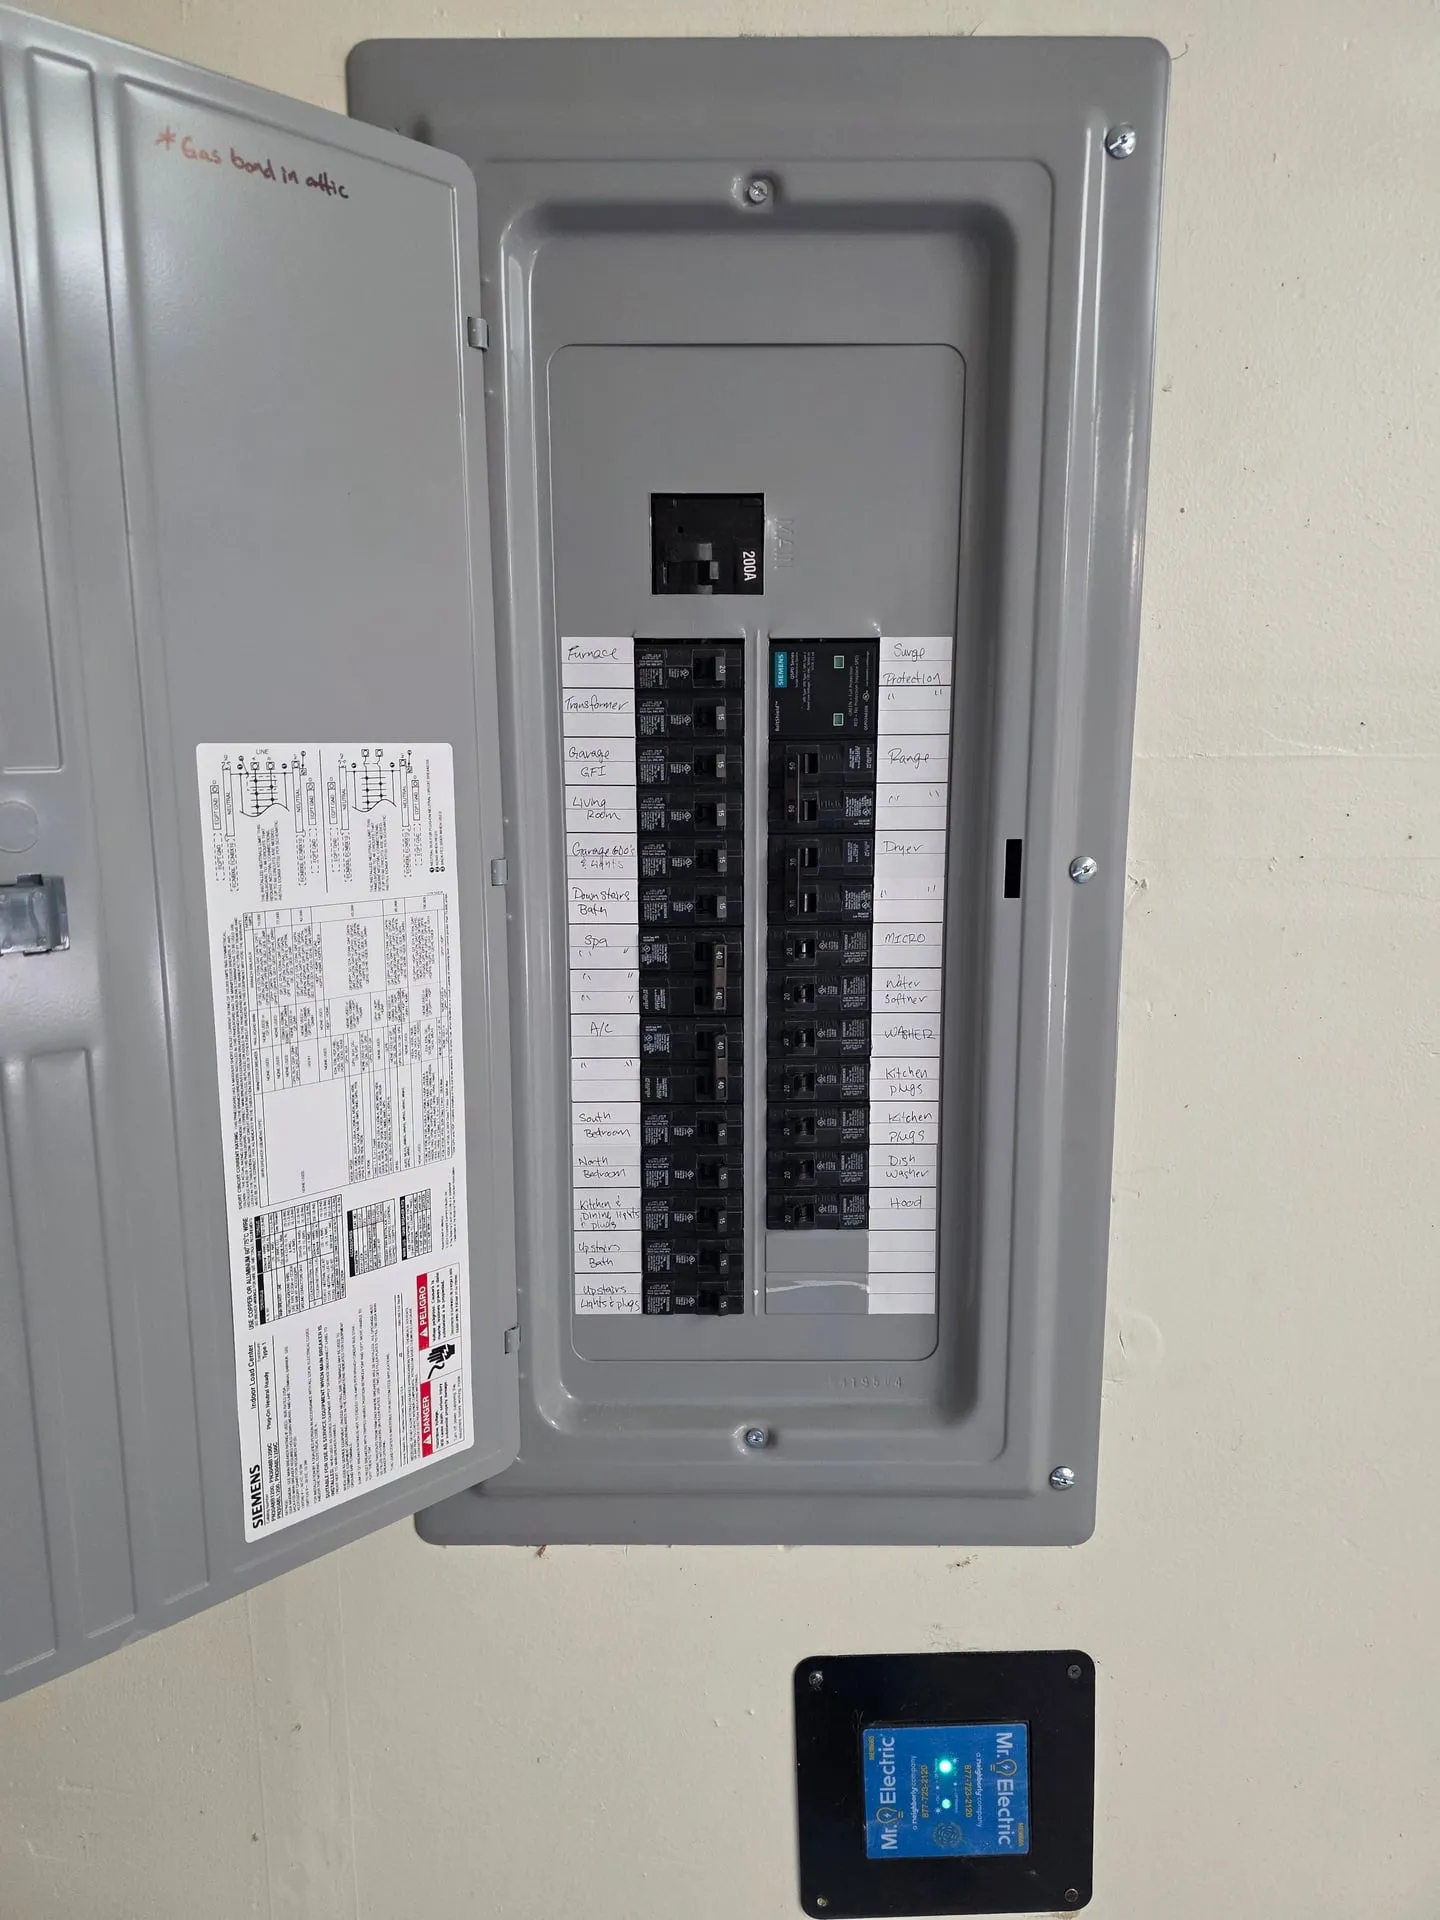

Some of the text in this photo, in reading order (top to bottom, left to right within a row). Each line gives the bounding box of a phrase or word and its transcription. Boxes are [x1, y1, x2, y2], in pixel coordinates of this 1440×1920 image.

[181, 136, 349, 199] Gas bond in attic
[743, 551, 756, 581] 200A
[568, 646, 619, 660] Furnace
[894, 643, 925, 662] Surge
[719, 665, 726, 674] 20
[883, 672, 940, 685] Protection
[565, 695, 629, 714] Transformer
[568, 746, 610, 763] Garage
[888, 748, 930, 768] Range
[581, 766, 606, 777] GFI
[573, 797, 606, 808] Living
[587, 809, 621, 820] Room
[883, 840, 924, 856] Dryer
[578, 904, 607, 917] Bath
[584, 935, 608, 949] Spa
[885, 933, 926, 944] MICRO
[716, 952, 723, 960] 40
[716, 992, 722, 1000] 40
[784, 993, 790, 1001] 20
[590, 1021, 613, 1036] A/C
[885, 1026, 936, 1041] WASHER
[718, 1041, 724, 1049] 40
[885, 1067, 928, 1079] Kitchen
[718, 1081, 725, 1090] 40
[579, 1112, 611, 1123] South
[889, 1111, 933, 1123] Kitchen
[584, 1128, 631, 1138] Bedroom
[578, 1156, 608, 1166] North
[888, 1155, 915, 1166] Dish
[583, 1168, 626, 1178] Bedroom
[784, 1171, 791, 1179] 20
[580, 1198, 612, 1210] Kitchen
[891, 1196, 922, 1208] Hood
[785, 1214, 792, 1223] 20
[589, 1257, 614, 1268] Bath
[247, 1286, 252, 1294] OR
[583, 1286, 626, 1295] Upstairs
[419, 1286, 427, 1325] PELIGRO
[249, 1464, 263, 1528] SIEMENS
[974, 1759, 983, 1796] neighborly
[878, 1737, 898, 1850] Mr. Electric
[920, 1765, 928, 1818] 877-723-2120
[964, 1765, 972, 1817] 877-723-2120
[996, 1733, 1015, 1845] Mr. Electric
